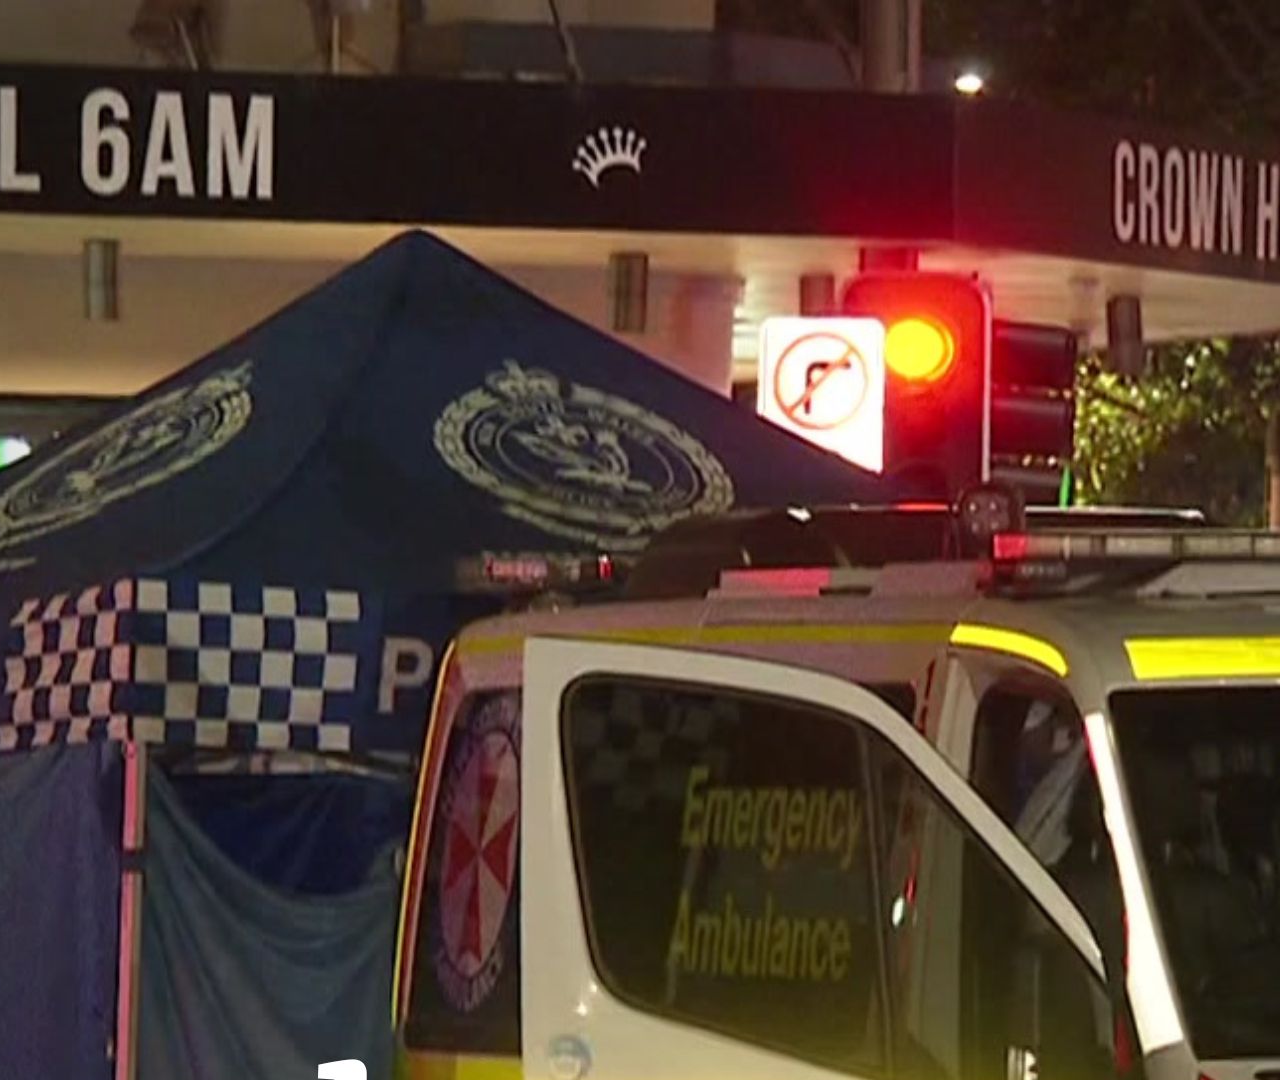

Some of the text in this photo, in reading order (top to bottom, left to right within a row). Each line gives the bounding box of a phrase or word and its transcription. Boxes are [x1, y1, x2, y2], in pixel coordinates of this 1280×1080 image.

[81, 88, 275, 201] 6AM
[1114, 140, 1244, 257] CROWN
[680, 765, 865, 873] Emergency
[668, 893, 851, 984] Ambulance
